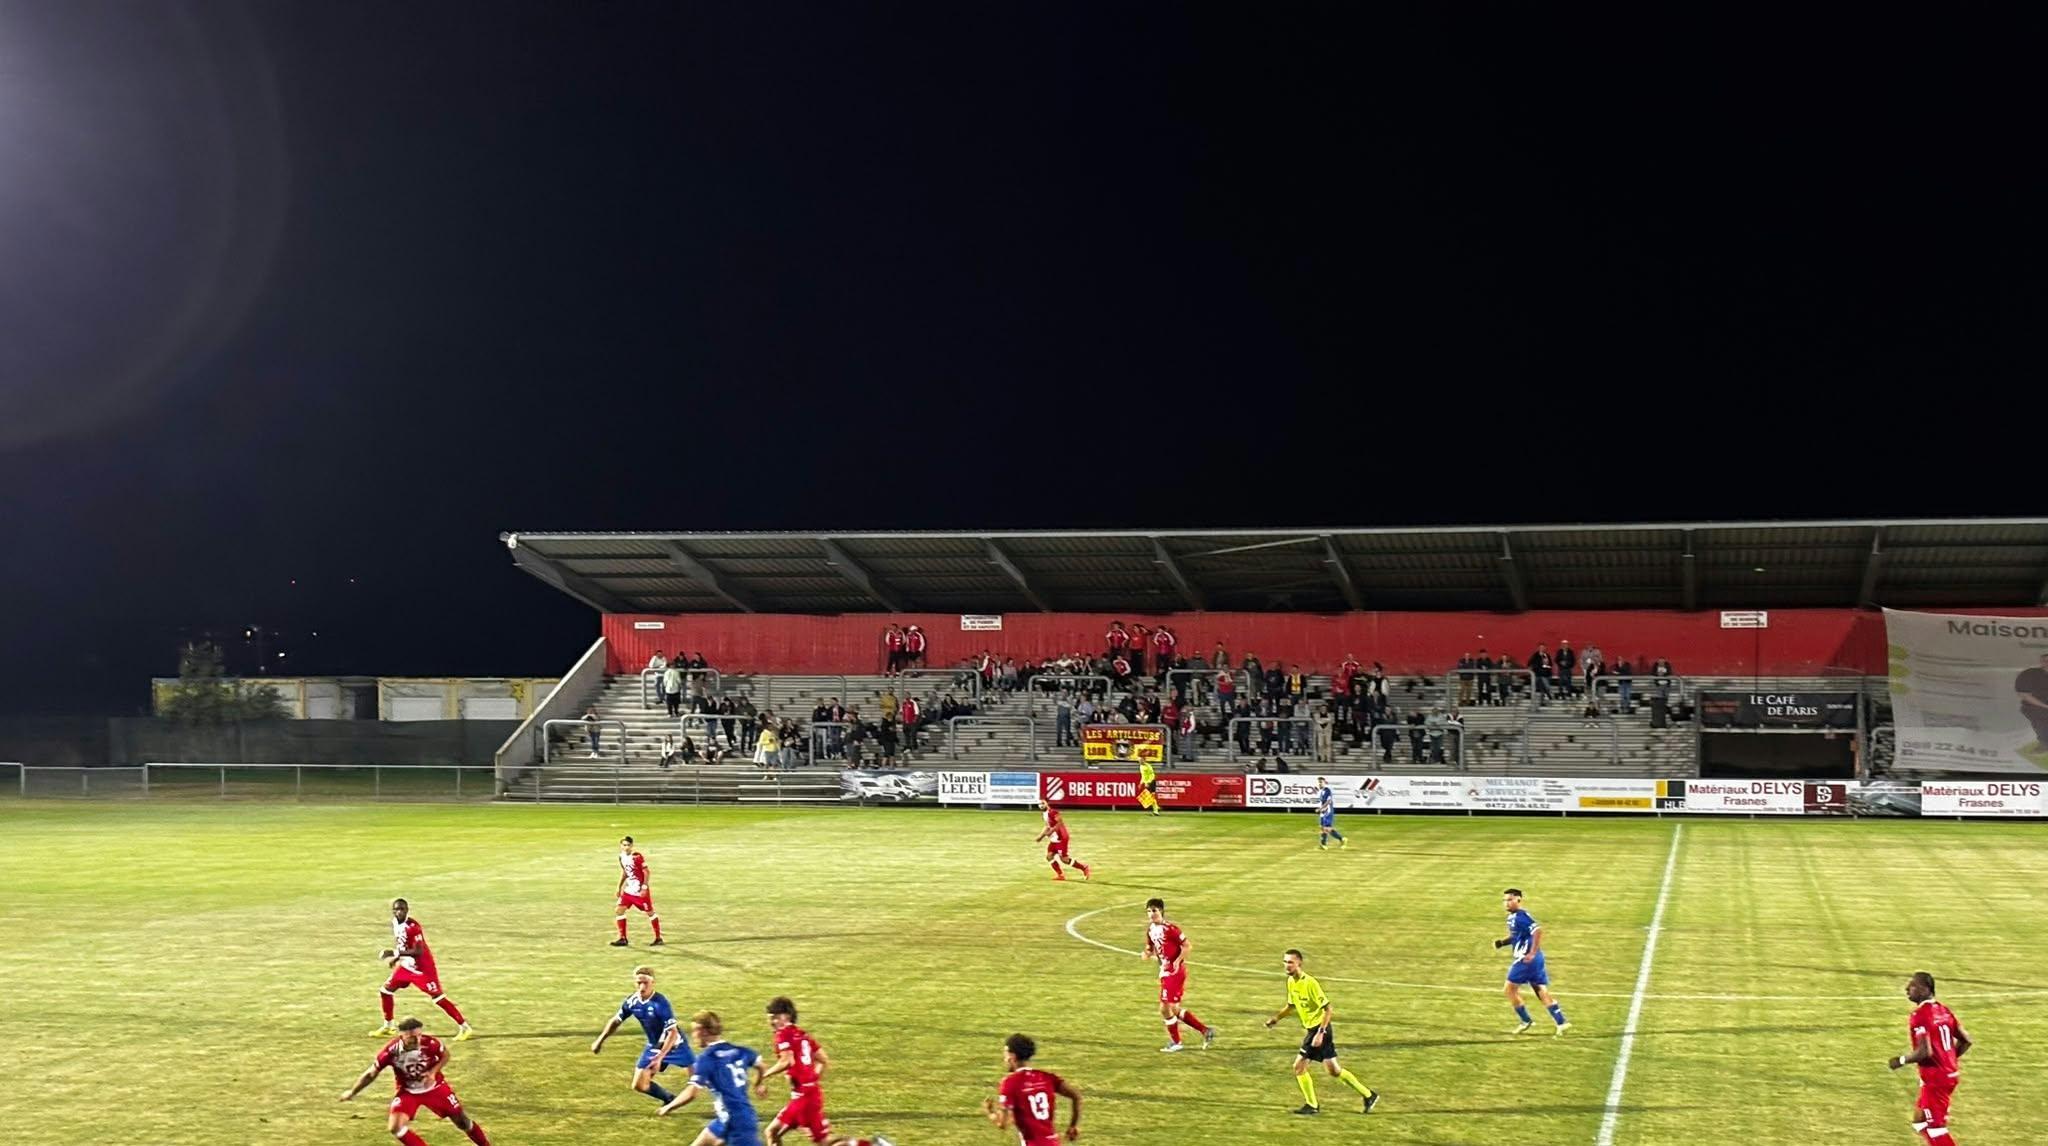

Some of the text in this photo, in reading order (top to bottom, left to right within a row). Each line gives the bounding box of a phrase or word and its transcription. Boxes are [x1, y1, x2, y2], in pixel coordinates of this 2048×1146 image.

[1947, 620, 2048, 638] Maison
[1750, 694, 1796, 705] LE CAFÉ
[1767, 706, 1784, 716] DE
[1786, 706, 1818, 716] PARIS
[1086, 730, 1102, 739] LES
[941, 773, 987, 784] Manuel
[941, 784, 987, 795] LELEU
[1069, 782, 1136, 798] BBE BETON
[1688, 782, 1803, 795] Matériaux DELYS
[1922, 785, 1985, 797] Matériaux
[1987, 783, 2041, 797] DELYS
[1723, 796, 1768, 806] Frasnes
[1959, 797, 2005, 808] Frasnes
[1027, 1091, 1050, 1120] 13
